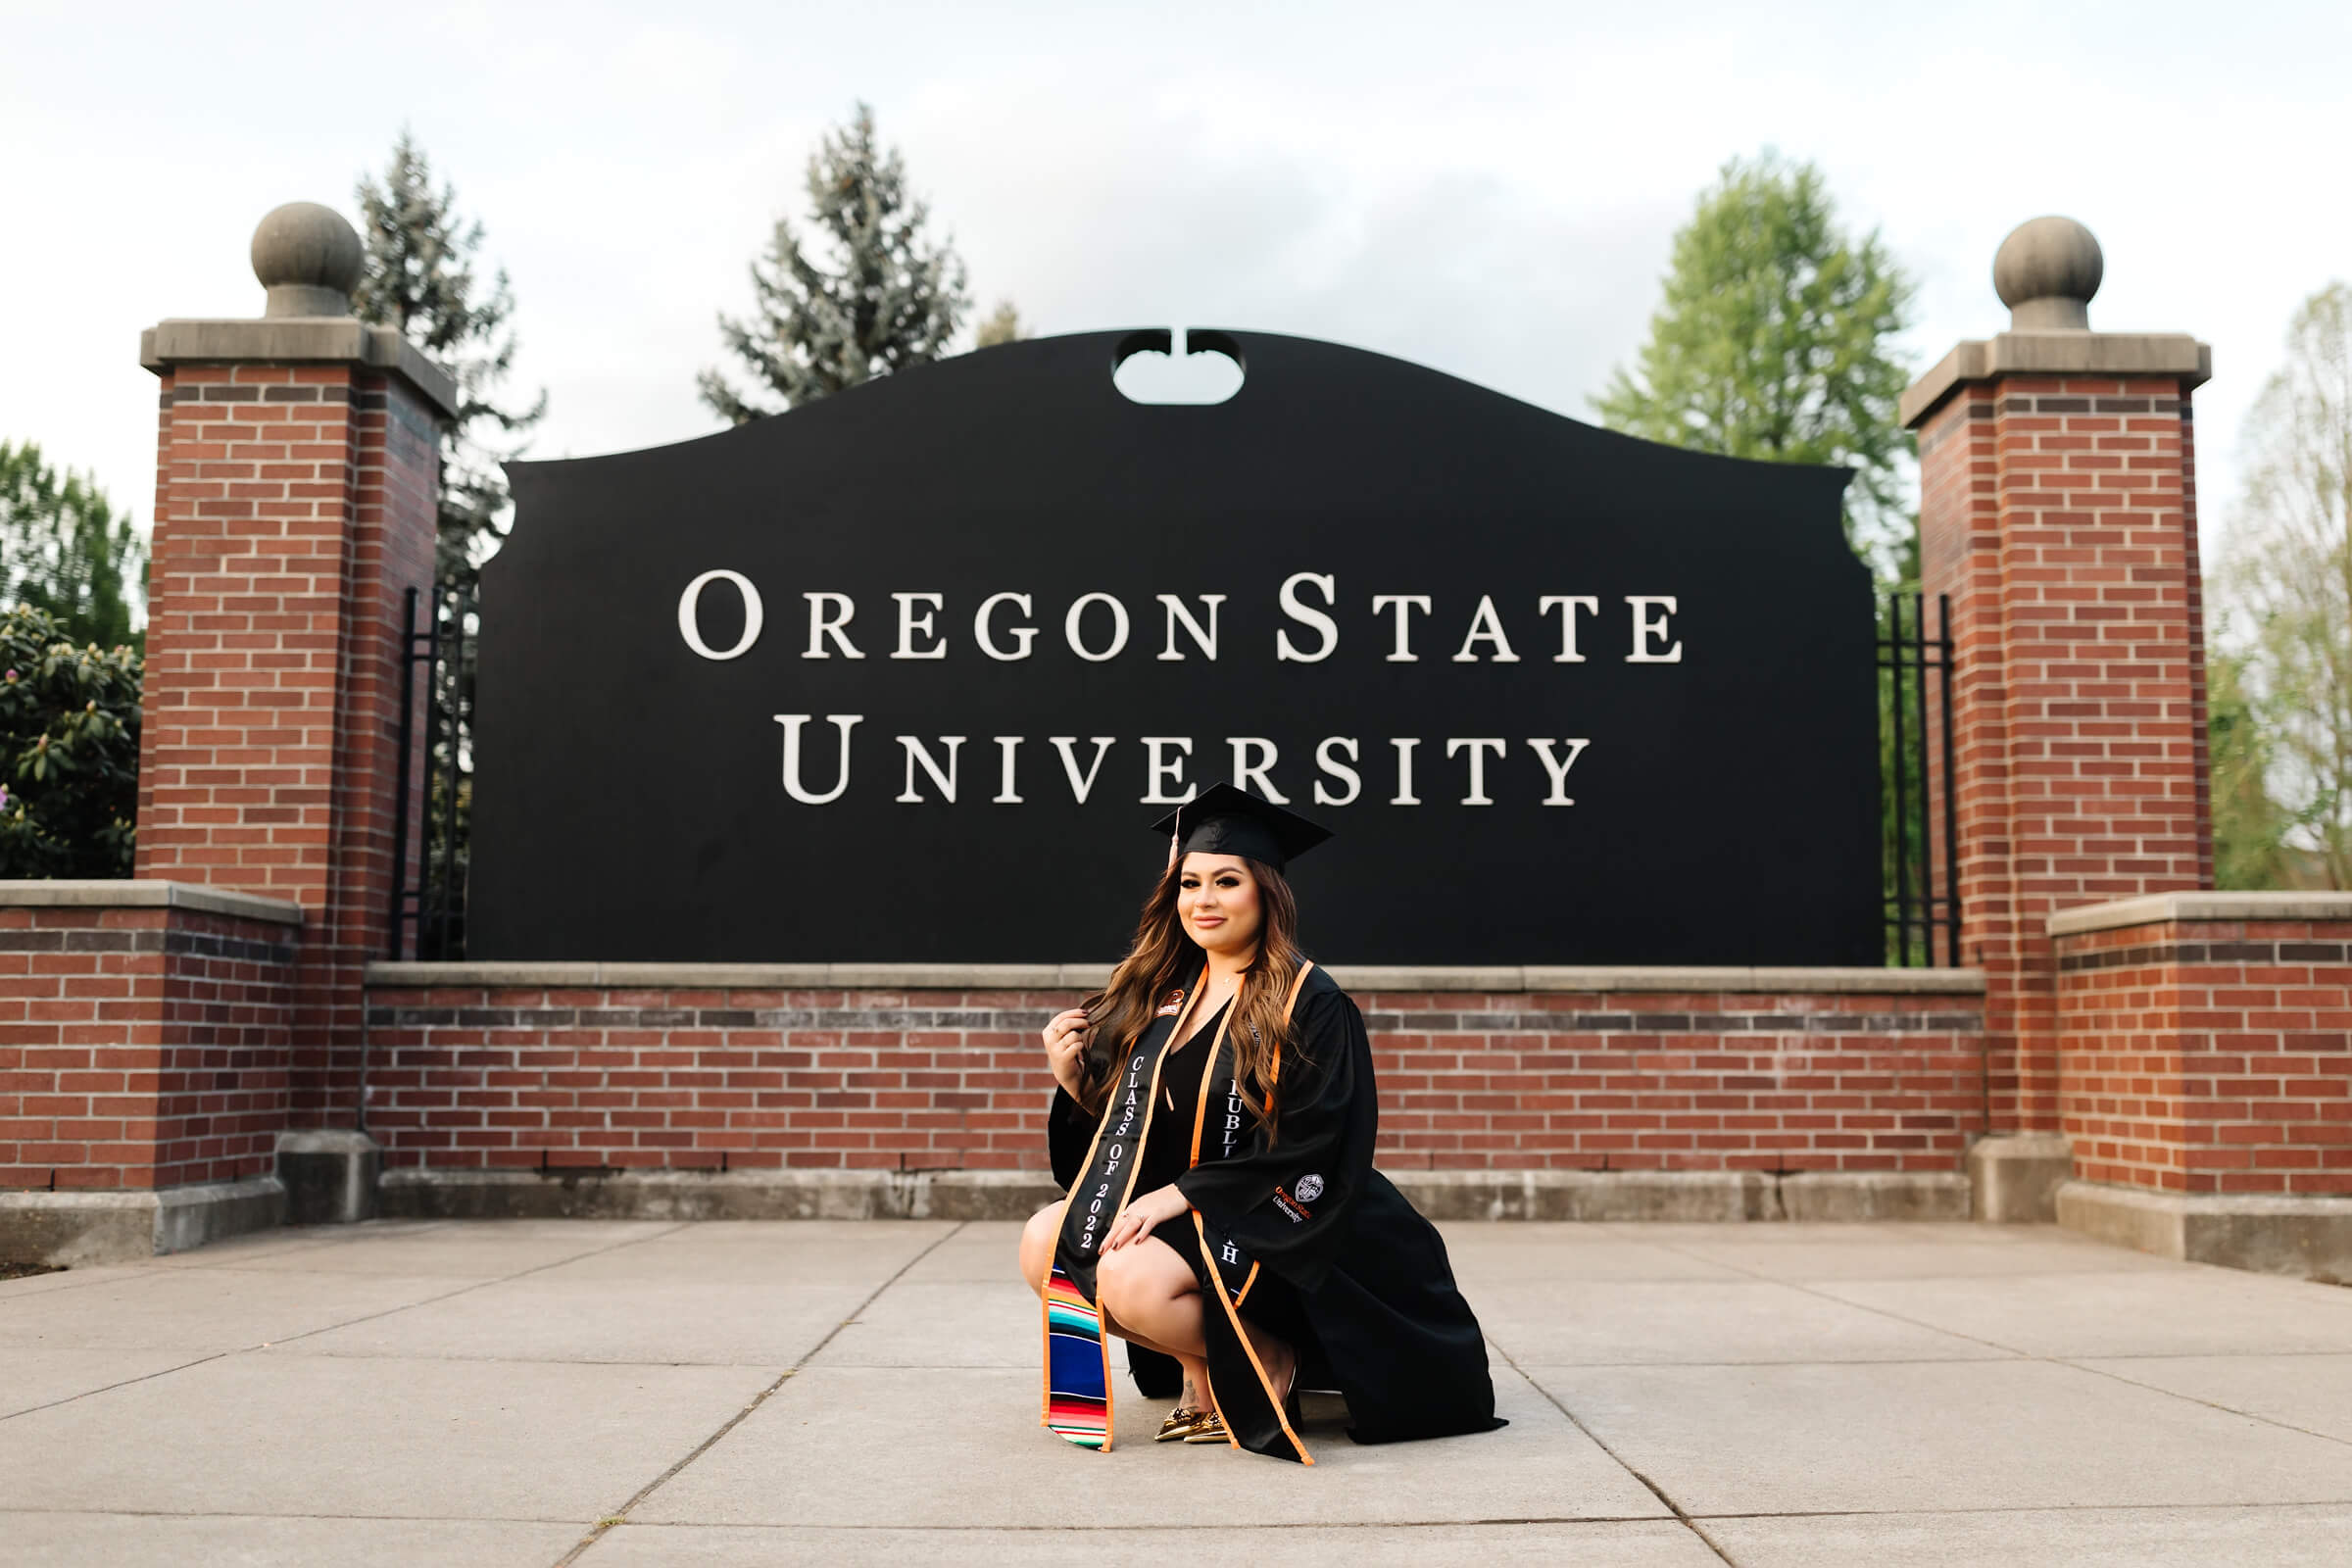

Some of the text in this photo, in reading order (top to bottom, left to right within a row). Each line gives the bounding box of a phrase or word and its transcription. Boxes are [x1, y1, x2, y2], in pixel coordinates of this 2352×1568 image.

[677, 569, 1683, 662] OREGON STATE
[773, 713, 1590, 806] UNIVERSITY
[1080, 1055, 1145, 1250] CLASS OF 2022
[1272, 1196, 1302, 1223] University
